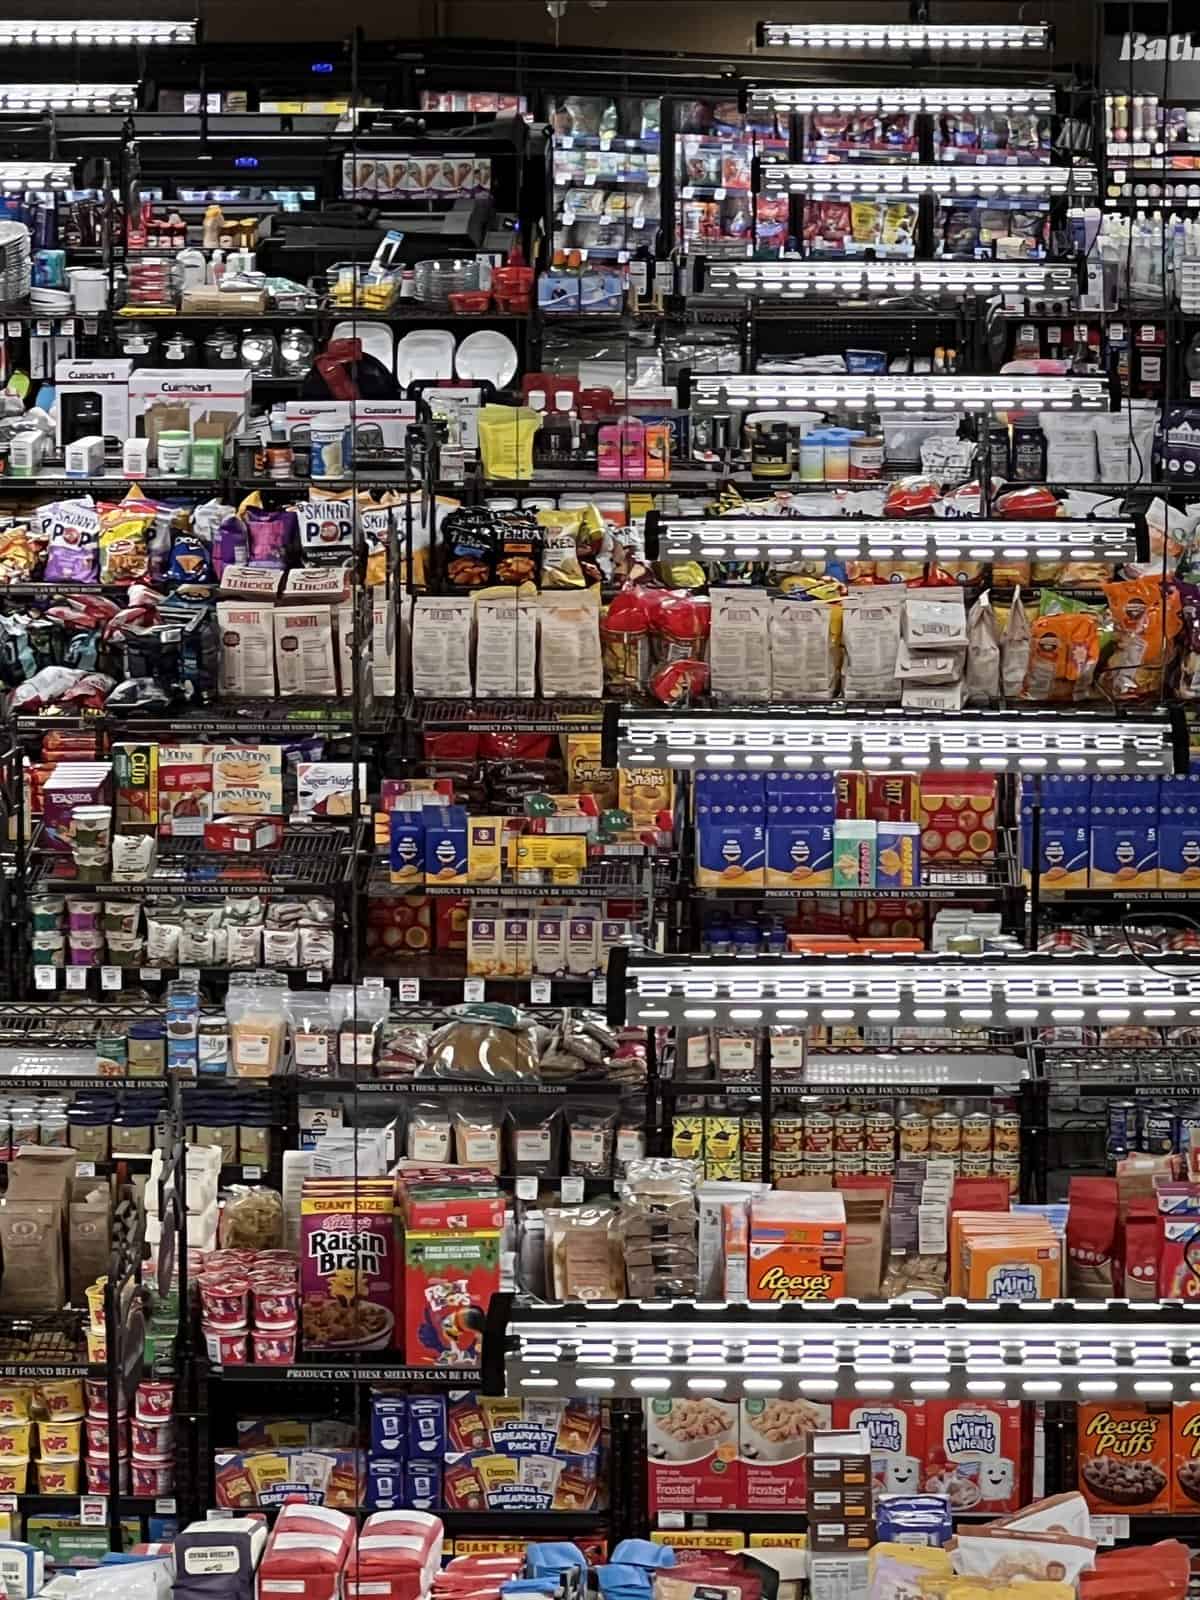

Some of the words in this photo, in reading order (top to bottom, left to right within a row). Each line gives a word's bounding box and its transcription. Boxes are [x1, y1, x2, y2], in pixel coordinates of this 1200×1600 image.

[496, 529, 542, 541] TERRA
[629, 774, 665, 788] Snaps
[314, 1201, 353, 1210] GIANT
[356, 1200, 384, 1210] SIZE
[310, 1232, 386, 1256] Raisin
[319, 1252, 379, 1274] Bran
[759, 1267, 832, 1290] Reese's
[995, 1275, 1034, 1294] Mini
[5, 1367, 17, 1376] BE
[19, 1367, 53, 1376] FOUND
[55, 1367, 89, 1376] BELOW
[286, 1370, 332, 1379] PRODUCT
[334, 1370, 350, 1379] ON
[352, 1370, 381, 1379] THESE
[383, 1370, 424, 1379] SHELVES
[426, 1370, 447, 1379] CAN
[449, 1370, 460, 1379] BE
[1086, 1412, 1158, 1435] Reese's
[493, 1430, 554, 1443] BREAKFAST
[951, 1422, 994, 1440] Mini
[508, 1441, 538, 1451] PACK
[948, 1436, 996, 1453] Wheats
[1096, 1434, 1154, 1457] Puffs
[656, 1484, 695, 1495] frosted
[747, 1485, 786, 1496] frosted
[489, 1493, 549, 1505] BREAKFAST
[662, 1536, 701, 1546] GIANT
[706, 1537, 733, 1546] SIZE
[762, 1538, 800, 1547] GIANT
[457, 1543, 497, 1552] GIANT
